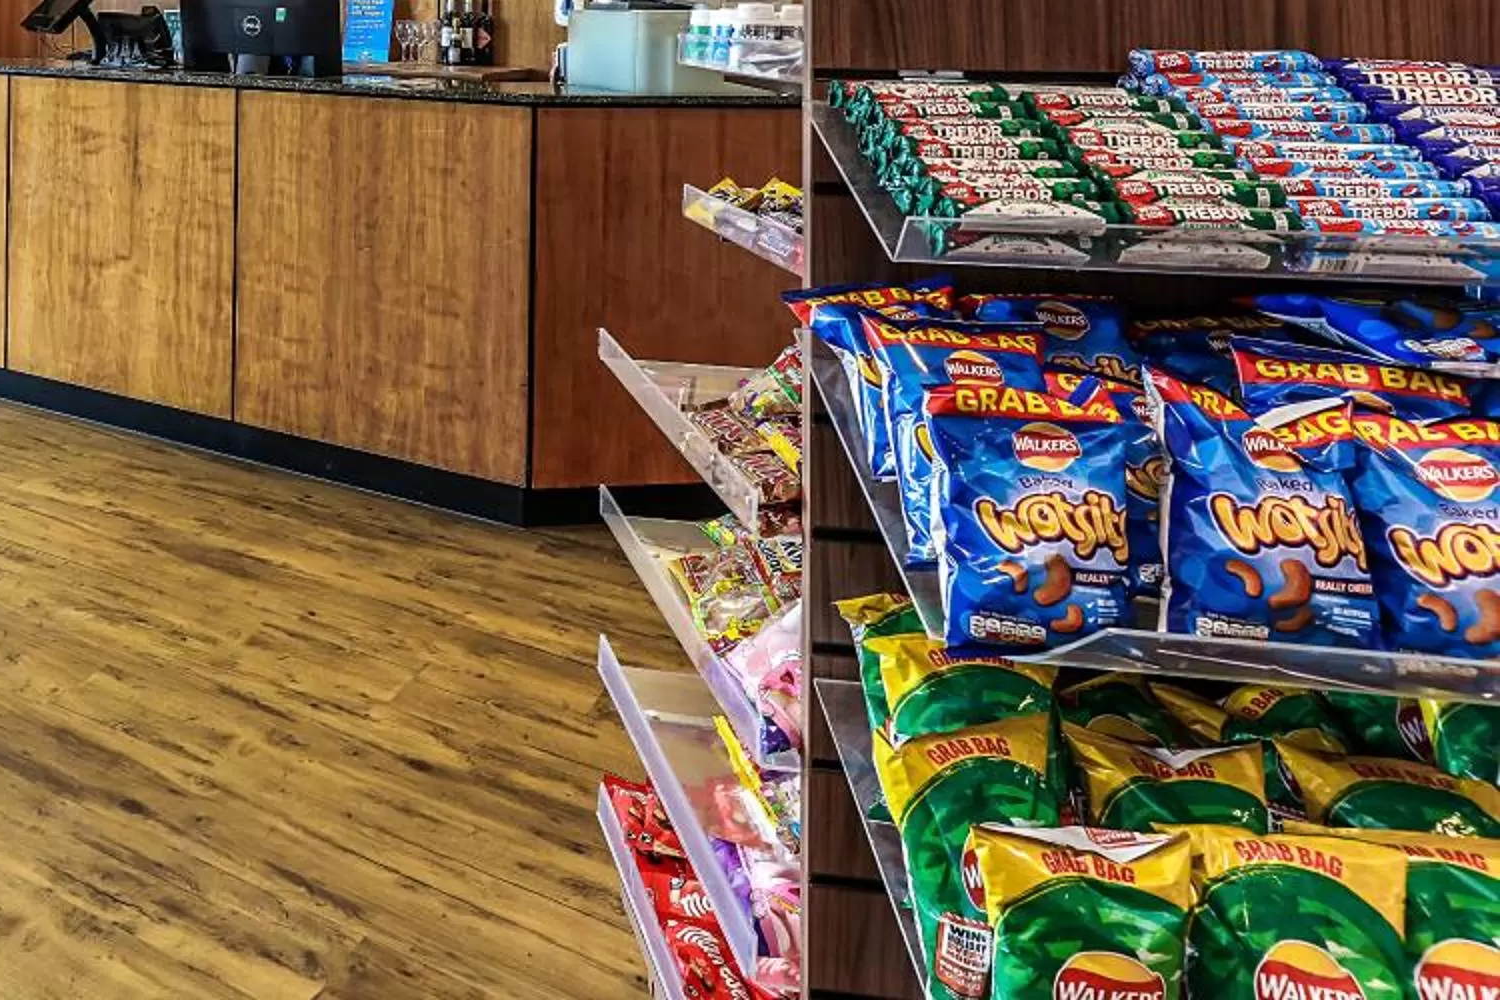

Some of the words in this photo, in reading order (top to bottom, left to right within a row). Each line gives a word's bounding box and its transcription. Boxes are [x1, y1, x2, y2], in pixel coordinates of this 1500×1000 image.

[1198, 60, 1255, 69] TREBOR
[1366, 71, 1471, 85] TREBOR
[1384, 87, 1498, 104] TREBOR
[915, 100, 982, 115] TREBOR
[1244, 107, 1305, 117] TREBOR
[934, 124, 1001, 137] TREBOR
[1105, 133, 1179, 149] TREBOR
[949, 146, 1019, 159] TREBOR
[1152, 182, 1235, 196] TREBOR
[1325, 186, 1391, 198] TREBOR
[1169, 208, 1253, 221] TREBOR
[1351, 208, 1419, 219] TREBOR
[1036, 309, 1088, 326] WALKERS
[948, 361, 1002, 377] WALKERS
[1255, 359, 1369, 384] GRAB
[1381, 367, 1462, 399] BAG
[955, 388, 1052, 414] GRAB
[1014, 436, 1077, 452] WALKERS
[1244, 437, 1288, 452] WALK
[1418, 465, 1495, 481] WALKERS
[927, 740, 972, 765] GRAB
[975, 736, 1011, 758] BAG
[1233, 841, 1294, 863] GRAB
[1299, 850, 1343, 878] BAG
[1421, 976, 1500, 1000] WALK
